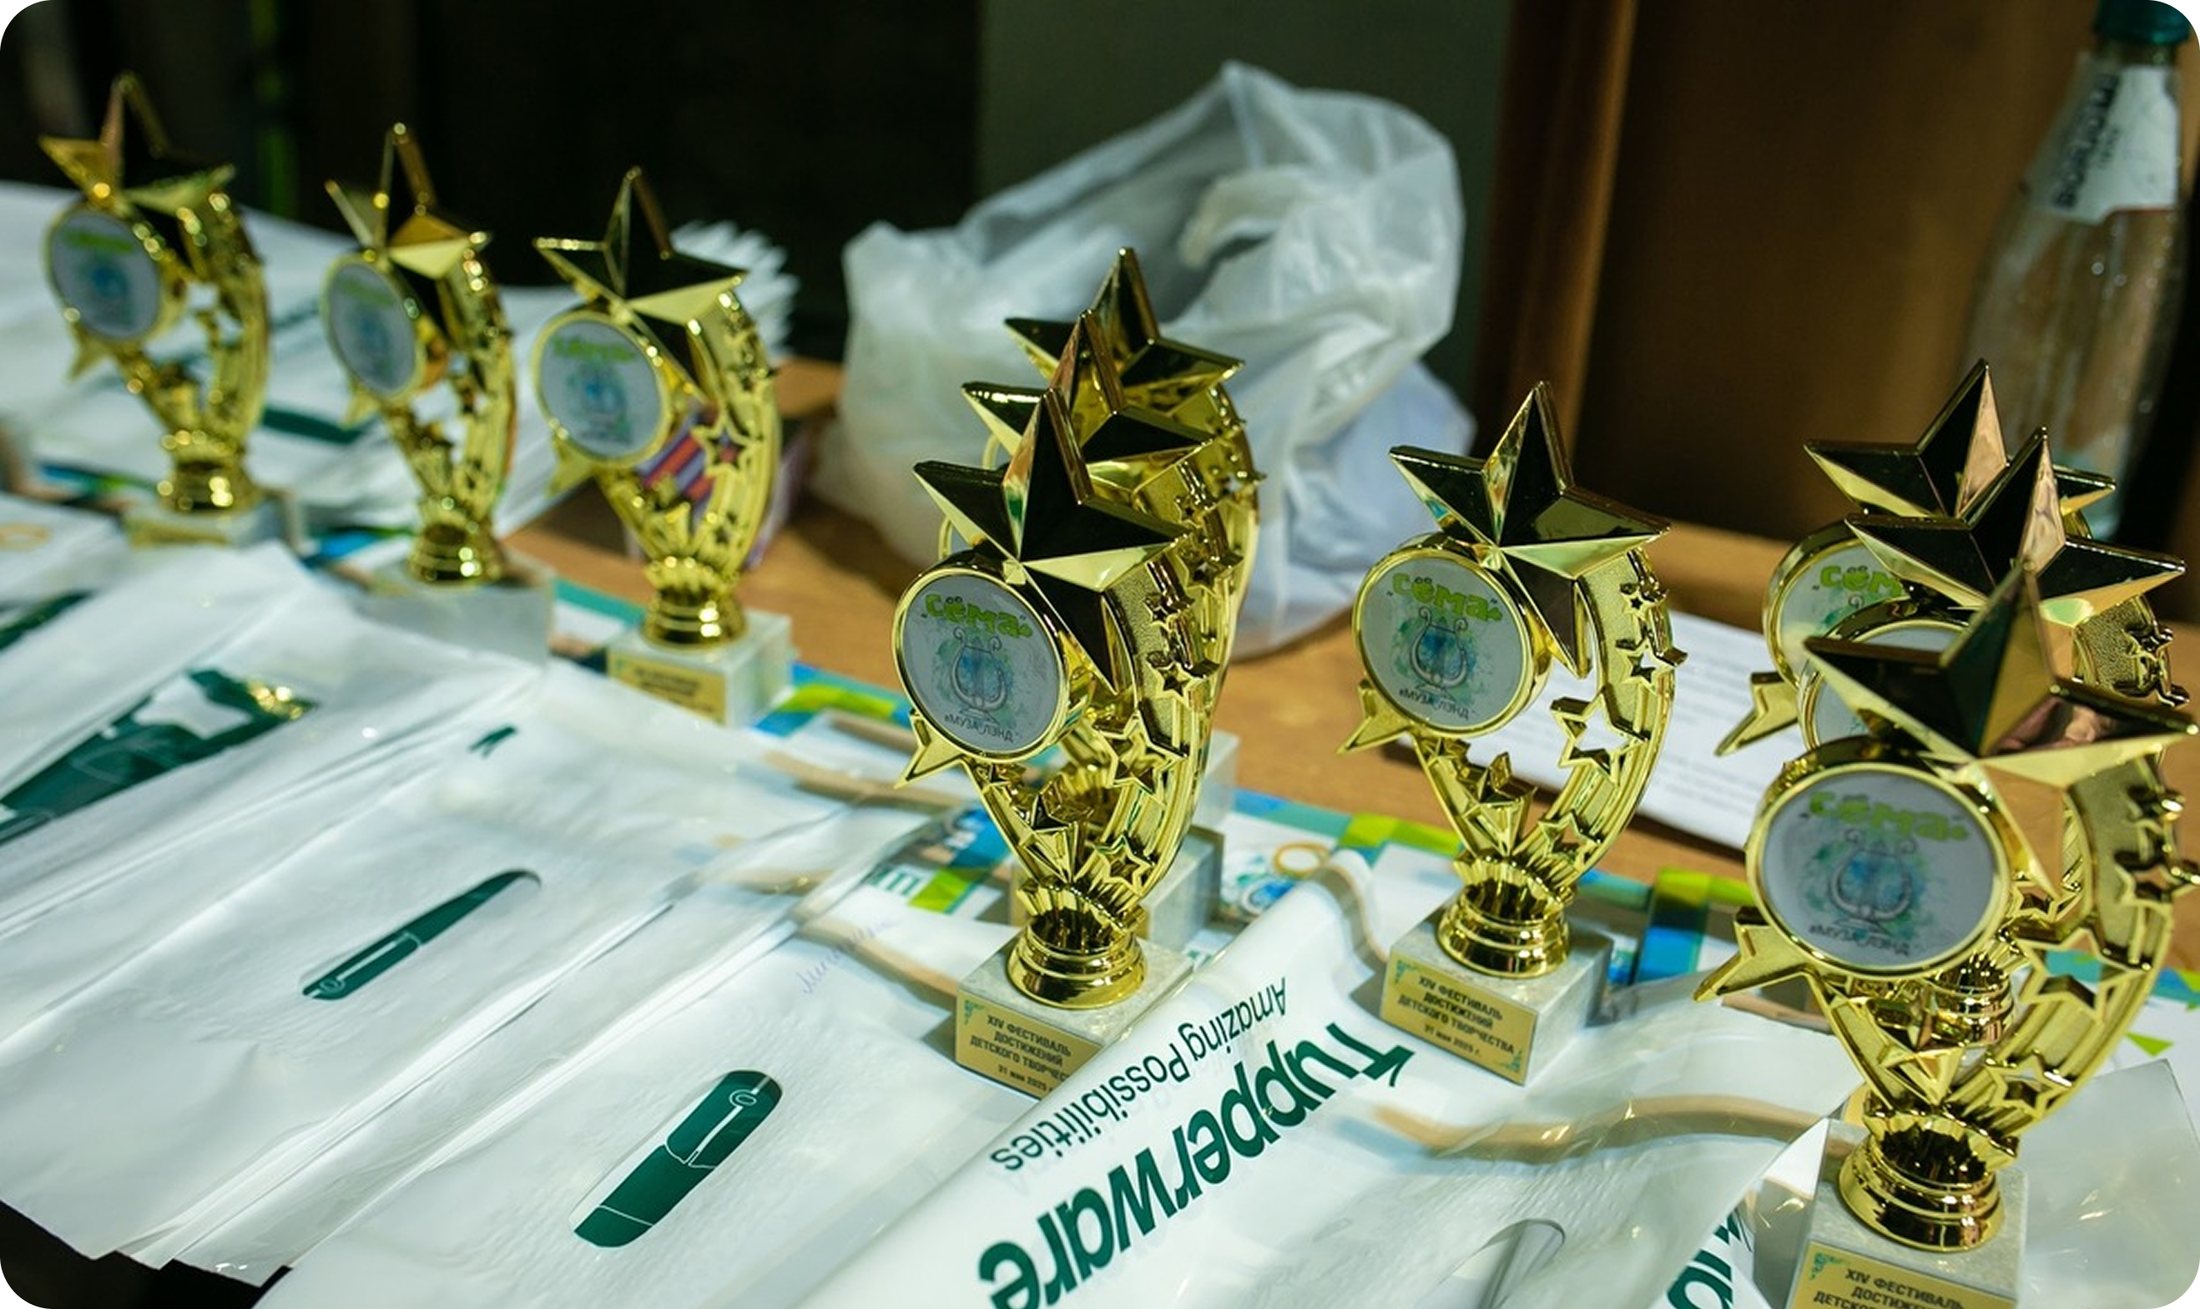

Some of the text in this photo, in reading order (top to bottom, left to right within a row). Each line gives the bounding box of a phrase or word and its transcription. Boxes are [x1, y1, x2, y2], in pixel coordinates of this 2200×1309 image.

[1418, 976, 1503, 1021] XIV ФЕСТИВАЛЬ
[1423, 992, 1493, 1030] ДОСТИЖЕНИЙ
[987, 1015, 1072, 1057] XIV ФЕСТИВАЛЬ
[1398, 994, 1515, 1055] ДЕТСКОГО ТВОРЧЕСТВА
[970, 1035, 1071, 1083] ДЕТСКОГО ТВОРЧЕС
[993, 1031, 1063, 1068] ДОСТИЖЕНИЙ
[990, 976, 1287, 1171] Amazing Possibilities
[978, 1023, 1416, 1309] Tupperware
[1845, 1269, 1871, 1284] XIV
